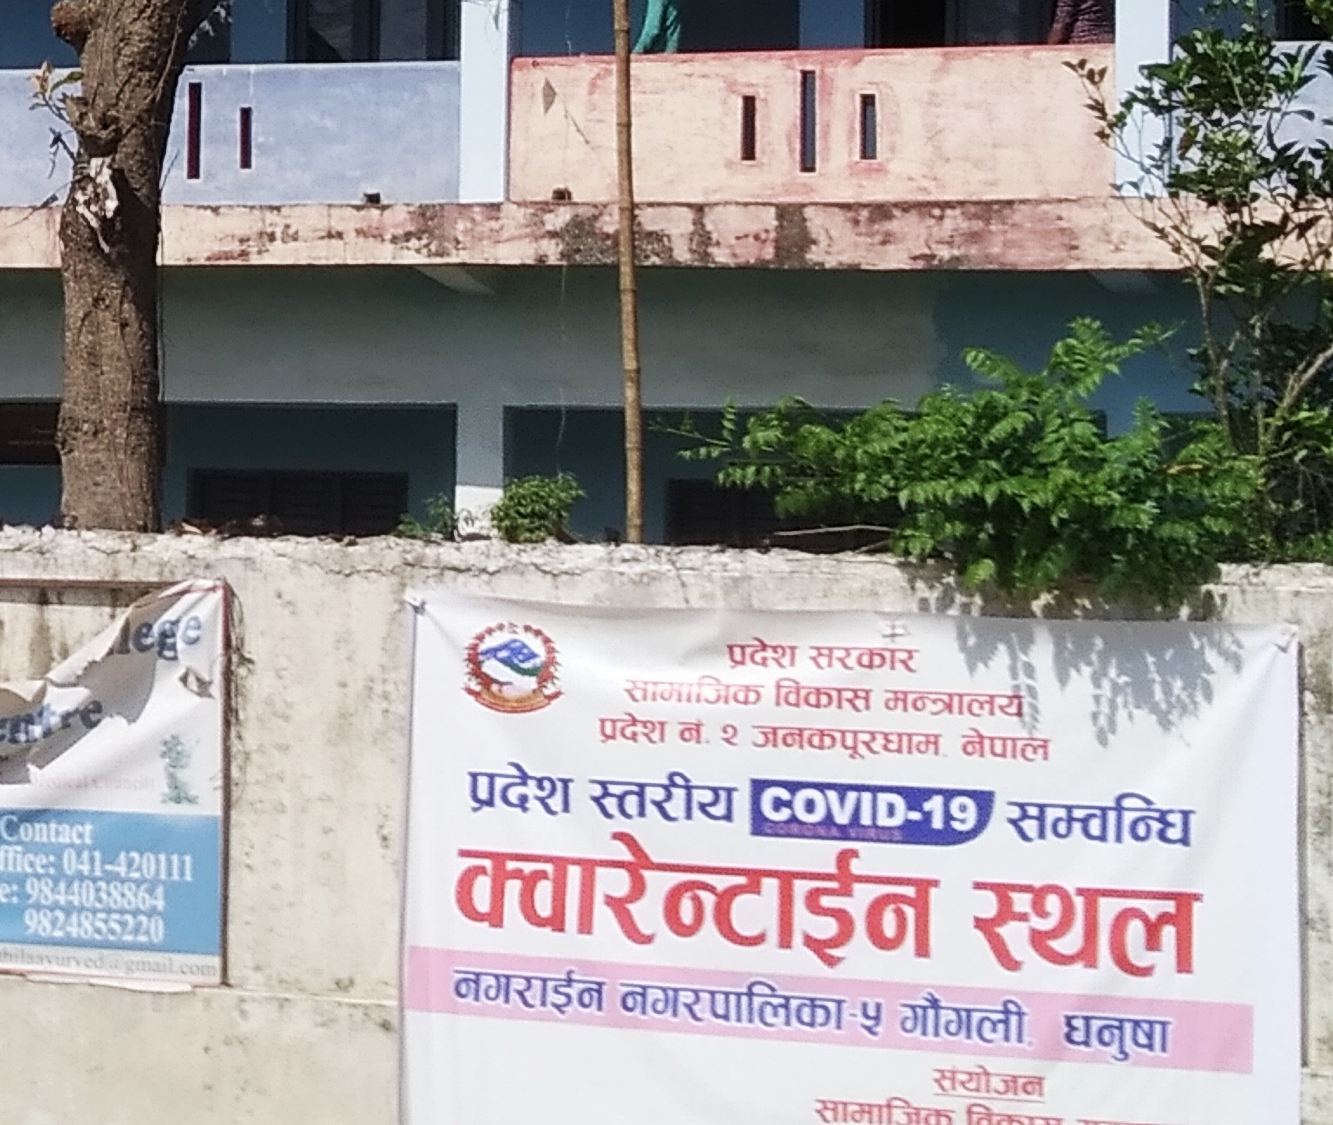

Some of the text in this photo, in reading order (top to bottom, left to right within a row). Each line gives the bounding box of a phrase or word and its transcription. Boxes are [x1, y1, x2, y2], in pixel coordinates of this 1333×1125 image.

[726, 637, 920, 673] प्रदेश सरकार
[623, 675, 1027, 720] सामाजिक विकास मन्त्रालय
[597, 712, 668, 745] प्रदेश
[720, 723, 739, 746] २
[961, 728, 1052, 762] नेपाल
[466, 761, 575, 816] प्रदेश
[587, 771, 739, 823] स्तरीय
[759, 785, 979, 832] COVID-19
[61, 846, 194, 882] 041-420111
[24, 876, 166, 913] 9844038864
[455, 830, 1203, 977] क्वारेन्टाईन स्थल
[23, 908, 166, 944] 9824855220
[453, 969, 608, 1017] नगराईन
[1063, 1014, 1172, 1061] धनुषा
